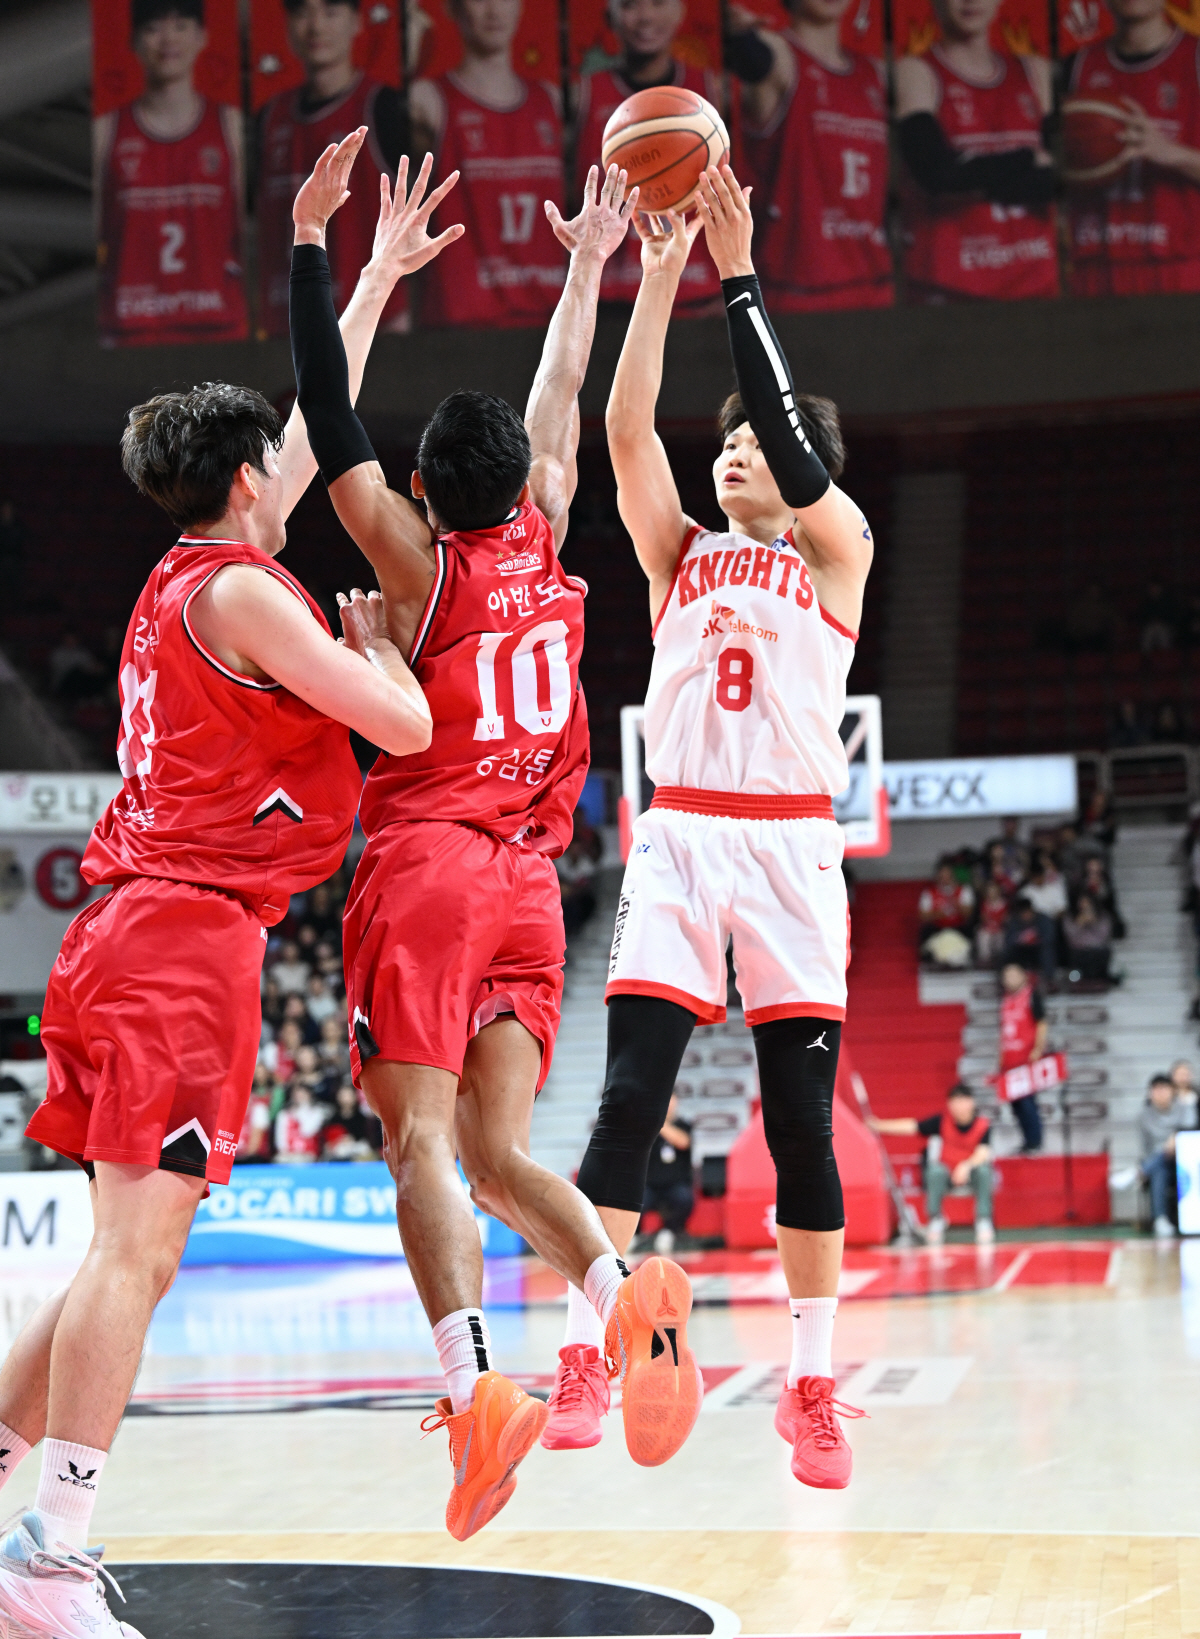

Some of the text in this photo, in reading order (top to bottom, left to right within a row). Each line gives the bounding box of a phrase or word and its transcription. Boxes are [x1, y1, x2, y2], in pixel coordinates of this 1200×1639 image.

[500, 193, 537, 243] 17
[160, 222, 185, 273] 2
[487, 575, 564, 618] 아반도
[678, 546, 814, 611] KNIGHTS
[729, 618, 778, 642] telecom
[473, 619, 571, 741] 10
[716, 648, 753, 712] 8
